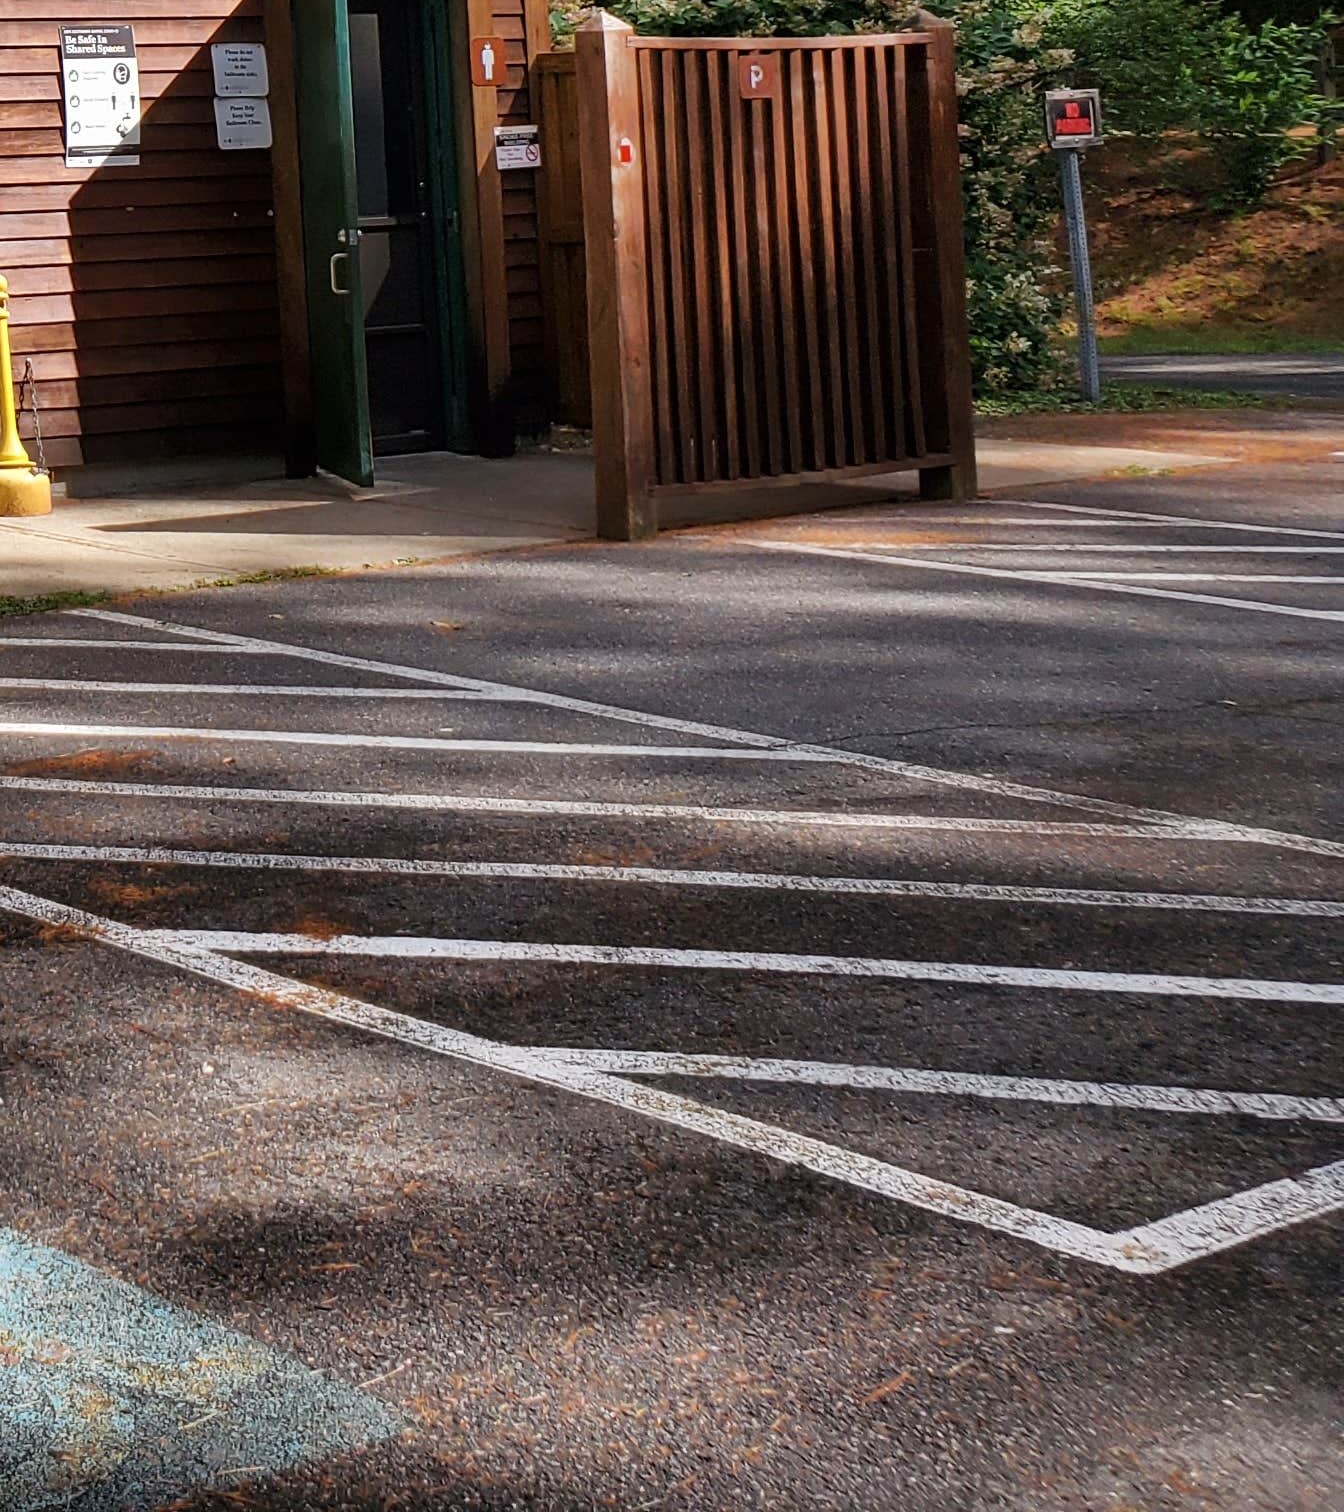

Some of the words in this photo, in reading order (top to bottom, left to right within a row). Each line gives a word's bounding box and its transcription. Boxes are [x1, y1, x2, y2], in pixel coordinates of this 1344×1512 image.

[65, 36, 77, 44] Be
[78, 35, 96, 44] Safe
[97, 35, 108, 44] In
[66, 45, 96, 54] Shared
[97, 44, 126, 55] Spaces
[750, 65, 764, 89] P
